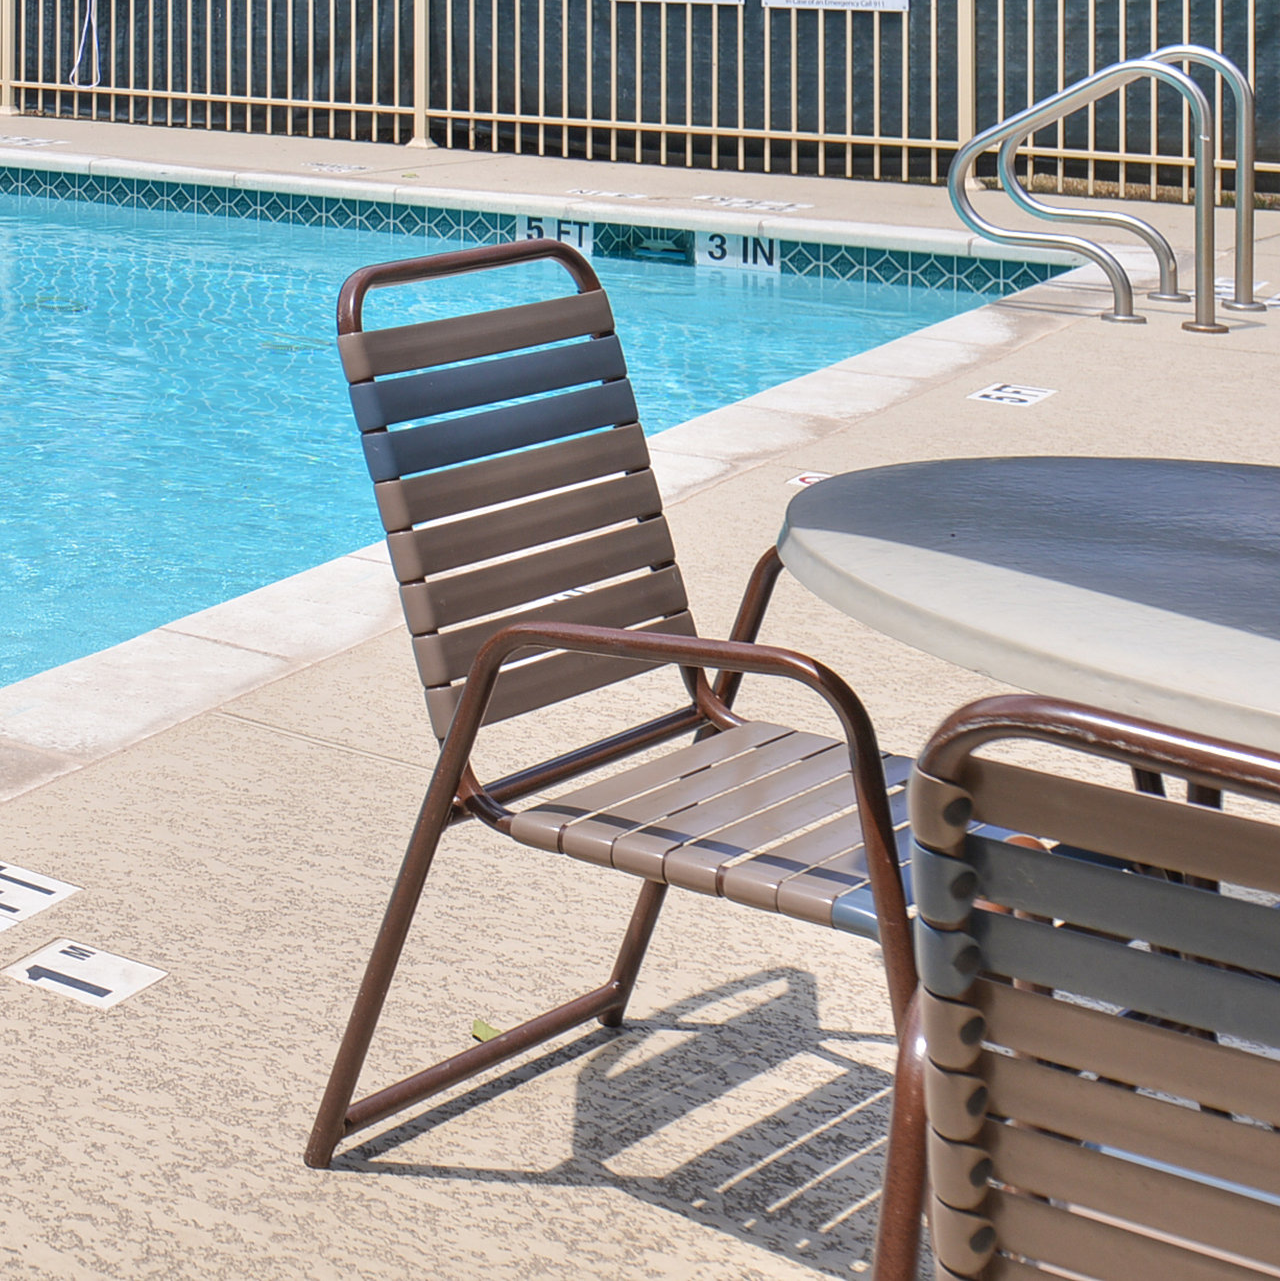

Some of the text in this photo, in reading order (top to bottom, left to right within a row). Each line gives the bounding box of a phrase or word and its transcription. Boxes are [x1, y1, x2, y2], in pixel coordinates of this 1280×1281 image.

[825, 0, 859, 7] Emergency
[526, 217, 775, 267] 5 FT 3 IN
[25, 964, 114, 999] 1
